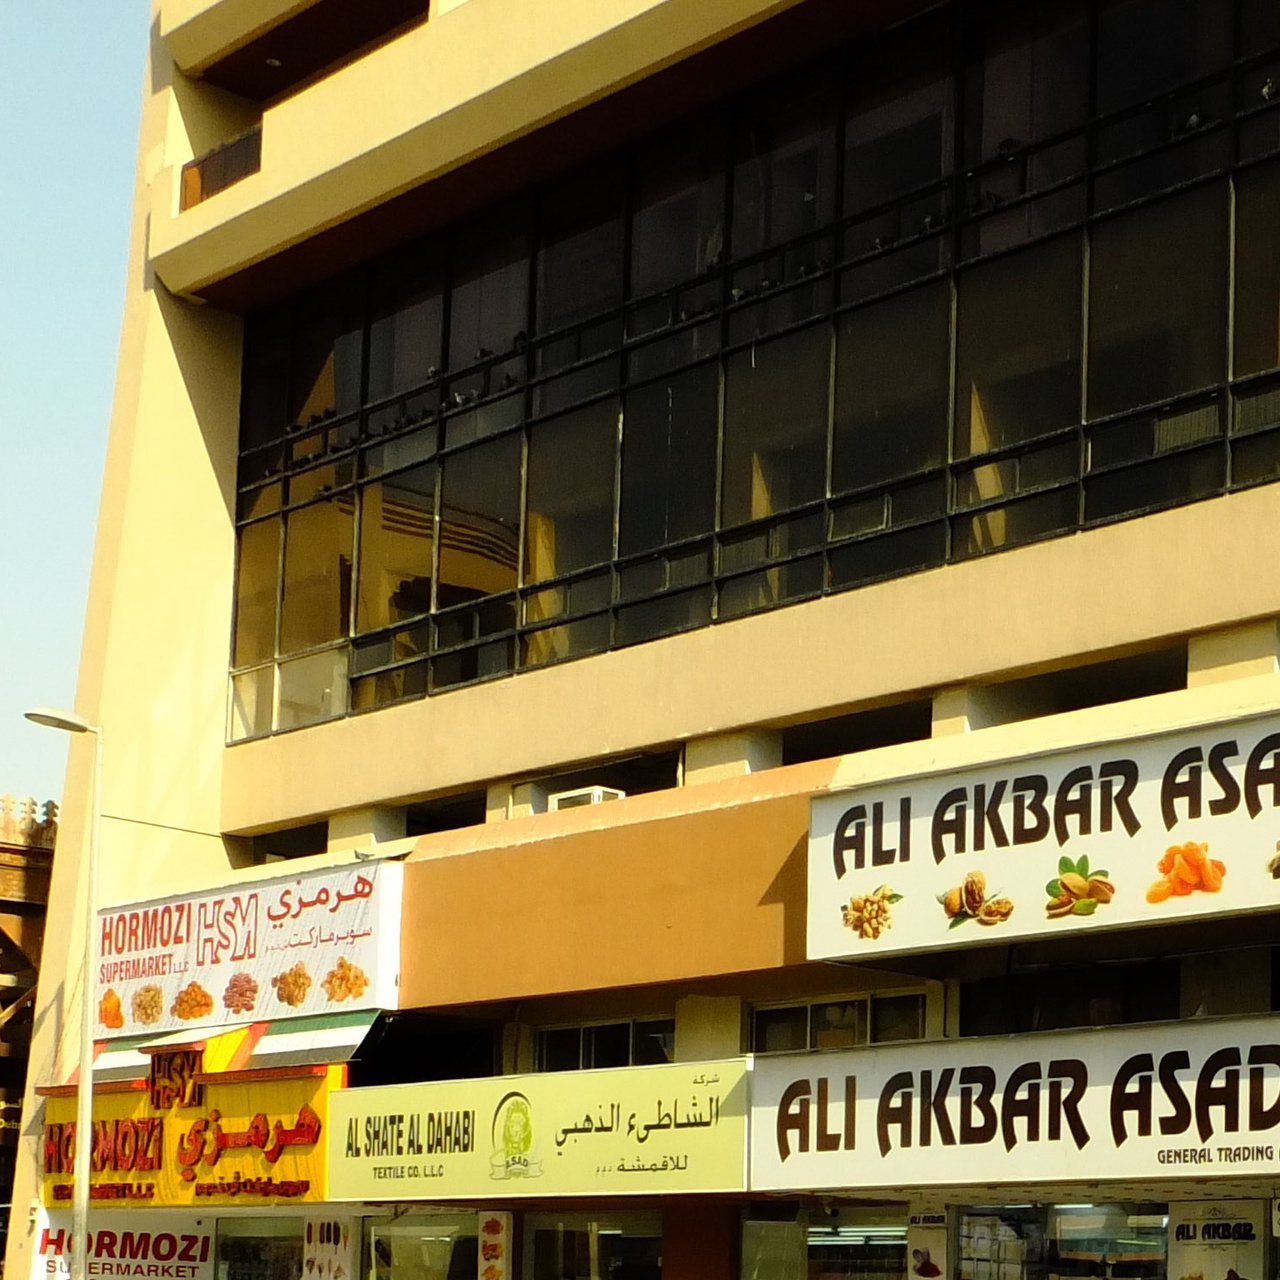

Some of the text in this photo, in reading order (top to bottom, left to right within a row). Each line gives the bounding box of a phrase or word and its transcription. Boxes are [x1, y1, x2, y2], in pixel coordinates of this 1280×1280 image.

[833, 797, 911, 880] ALI
[931, 759, 1142, 867] AKBAR
[100, 902, 192, 957] HORMOZI
[196, 893, 258, 967] HSM
[267, 875, 374, 930] هرمزي
[100, 953, 174, 984] SUPERMARKET
[346, 1110, 475, 1158] AL SHATE AL DAHABI
[555, 1101, 620, 1156] الذهبي
[777, 1075, 856, 1163] ALI
[876, 1059, 1091, 1159] AKBAR
[178, 1103, 321, 1182] هرمزي
[1157, 1148, 1213, 1165] GENERAL
[1217, 1146, 1274, 1163] TRADING
[373, 1166, 405, 1180] TEXTILE
[408, 1165, 420, 1179] CO.
[1176, 1223, 1256, 1241] ALI AKBAR
